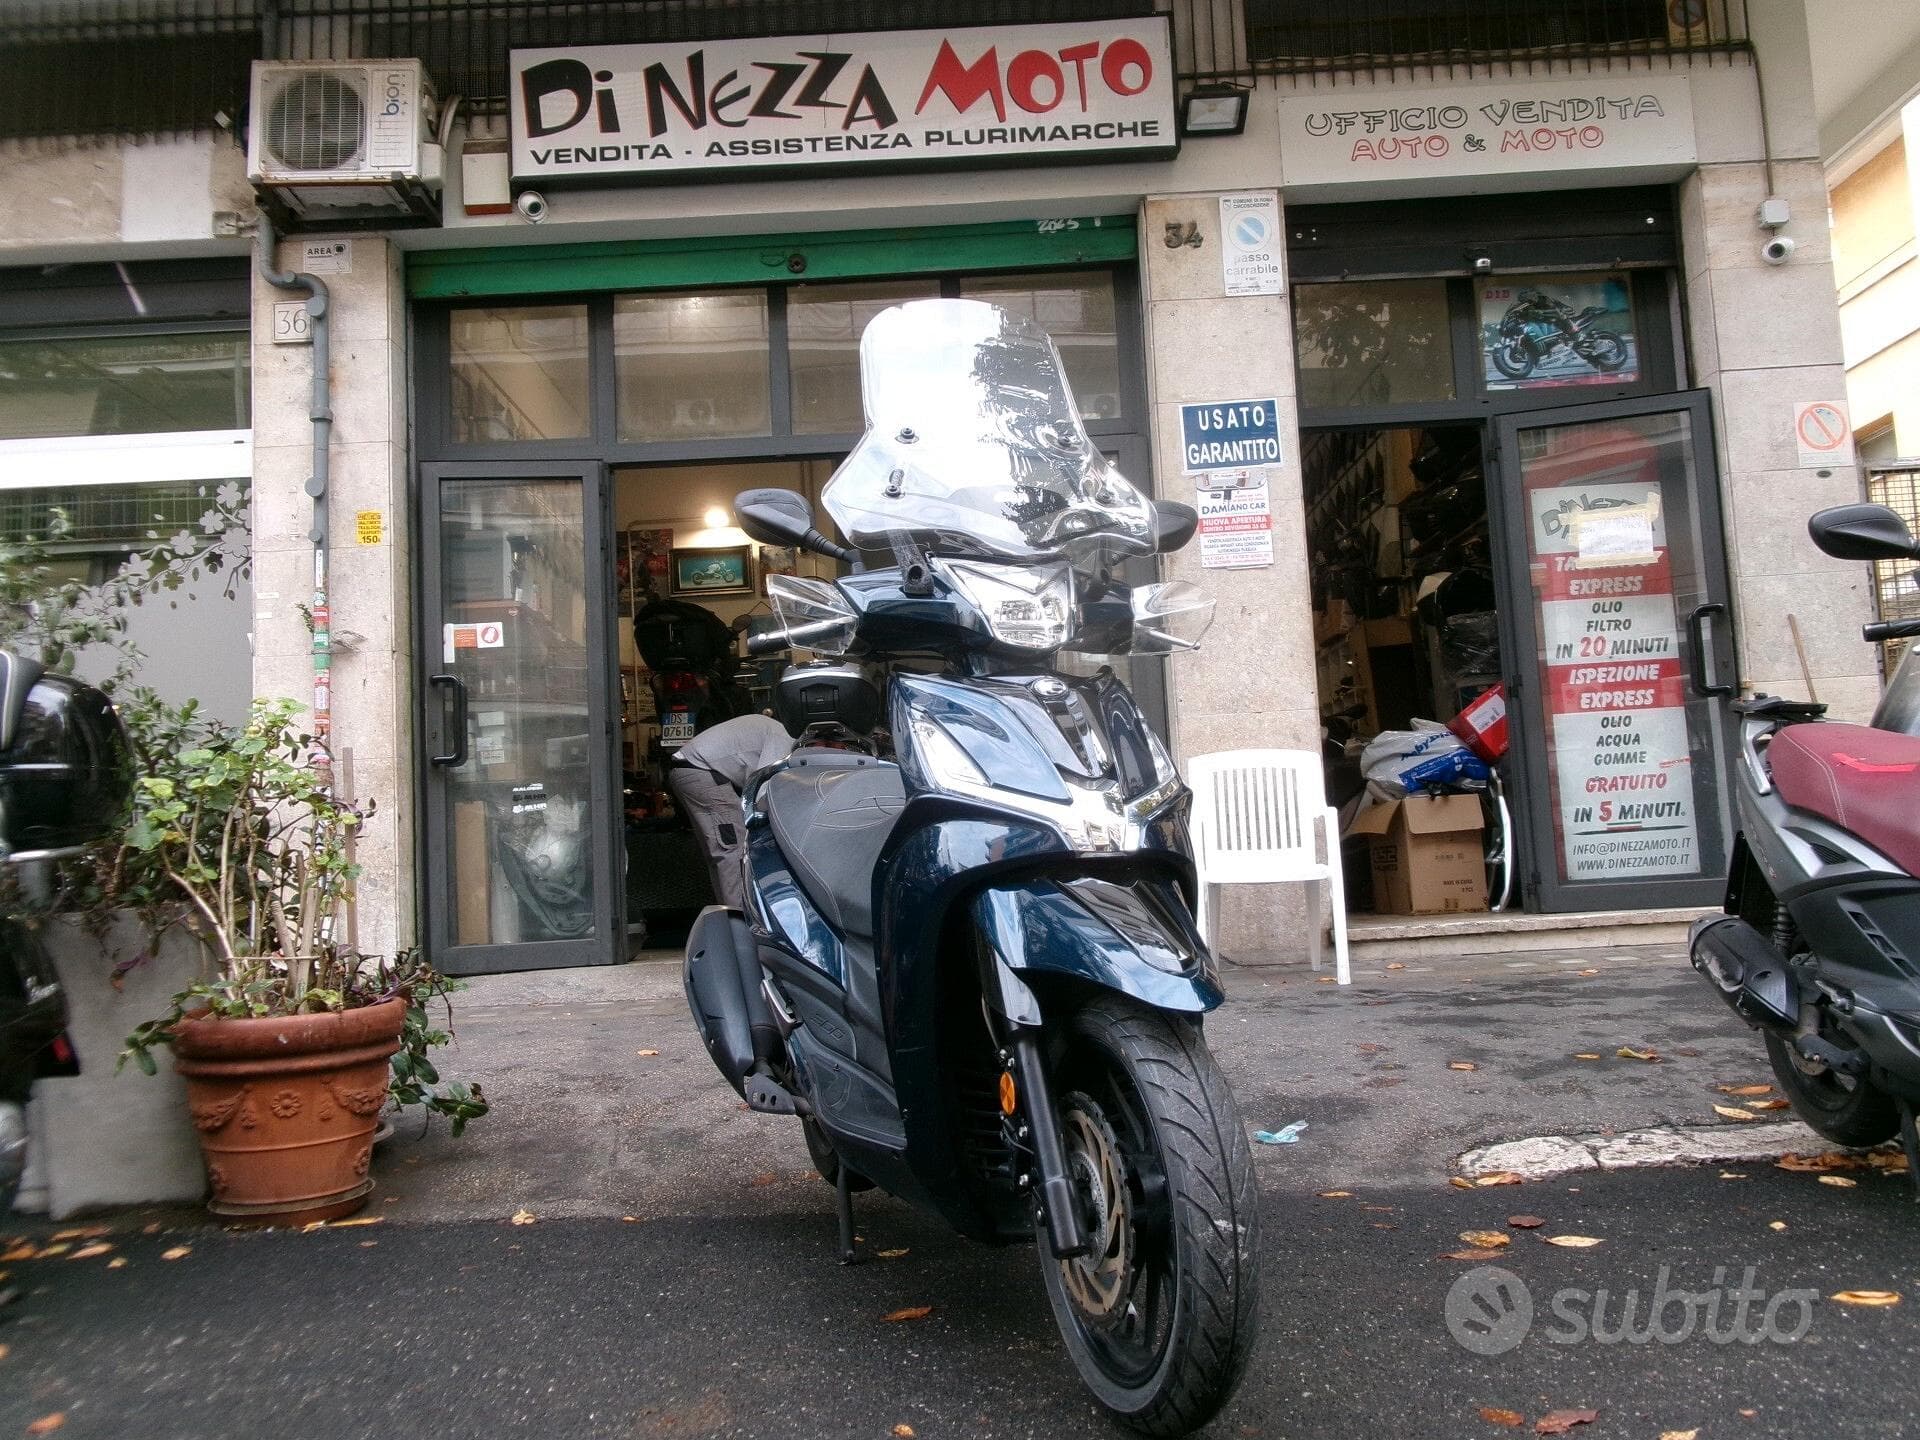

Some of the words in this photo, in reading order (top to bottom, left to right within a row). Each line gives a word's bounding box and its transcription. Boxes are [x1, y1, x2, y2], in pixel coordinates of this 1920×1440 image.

[380, 74, 400, 116] bion
[520, 58, 620, 138] Di
[914, 37, 1152, 123] MOTO
[1304, 105, 1468, 136] UFFICIO
[1479, 95, 1664, 127] VENDITA
[530, 144, 672, 165] VENDITA
[705, 133, 912, 157] ASSISTENZA
[924, 120, 1160, 146] PLURIMARCHE
[1351, 135, 1449, 161] AUTO
[1463, 134, 1486, 152] &
[1501, 125, 1604, 153] MOTO
[307, 247, 332, 255] AREA
[1226, 264, 1279, 275] carrabile
[278, 309, 307, 335] 36
[1197, 405, 1265, 431] USATO
[1187, 438, 1278, 464] GARANTITO
[1201, 503, 1248, 515] DAMIANO
[1249, 502, 1266, 510] CAR
[1203, 518, 1229, 526] NUOVA
[1231, 515, 1268, 524] APERTURA
[1569, 575, 1644, 596] EXPRESS
[1591, 601, 1623, 614] OLIO
[1586, 619, 1632, 632] FILTRO
[1555, 643, 1574, 659] IN
[1579, 636, 1607, 657] 20
[1610, 637, 1669, 656] MINUTI
[1569, 664, 1660, 685] ISPEZIONE
[1580, 689, 1656, 709] EXPRESS
[663, 725, 693, 738] 07618
[1601, 715, 1632, 729] OLIO
[1596, 733, 1641, 748] ACQUA
[1594, 751, 1647, 766] GOMME
[1585, 773, 1667, 793] GRATUITO
[1573, 807, 1592, 823] IN
[1599, 801, 1613, 822] 5
[1573, 837, 1691, 856] INFO@DINEZZAMOTO.IT
[1577, 854, 1690, 871] WWW.DINEZZAMOTO.IT
